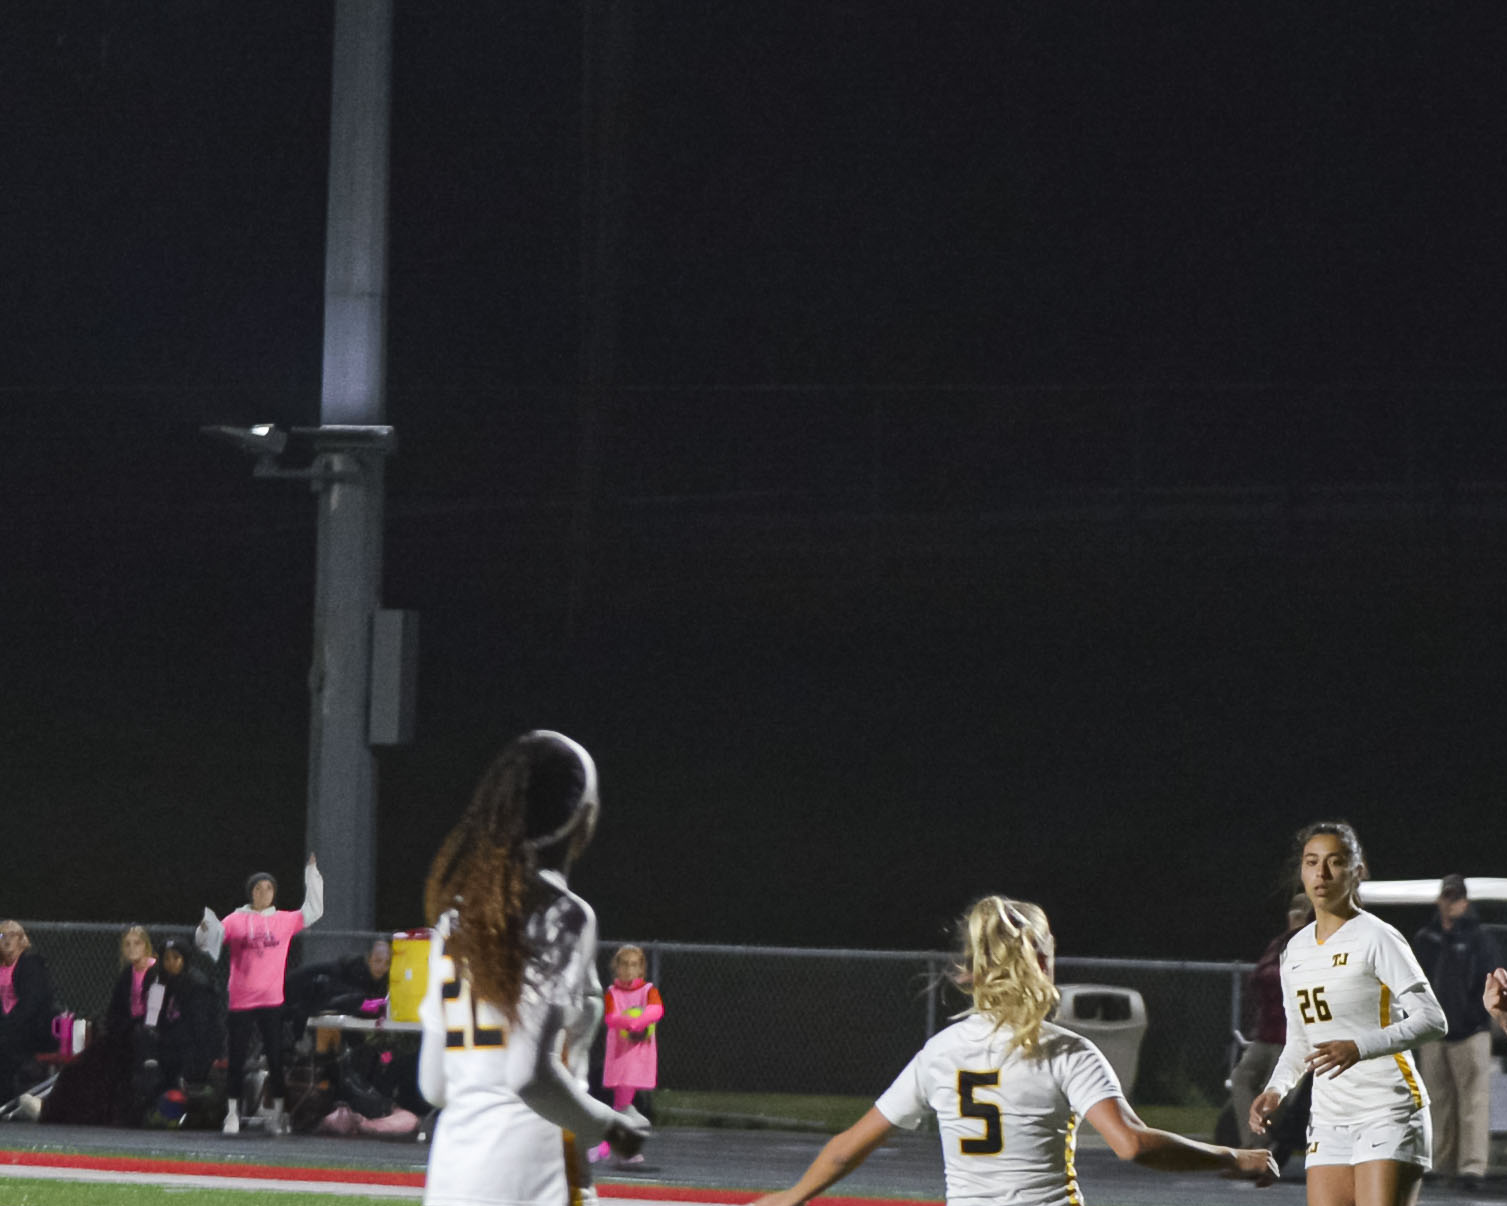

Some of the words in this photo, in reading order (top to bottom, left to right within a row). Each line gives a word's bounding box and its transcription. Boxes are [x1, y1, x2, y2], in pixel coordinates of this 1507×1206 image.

[1331, 952, 1350, 968] TJ
[1296, 986, 1333, 1025] 26
[956, 1069, 1005, 1157] 5
